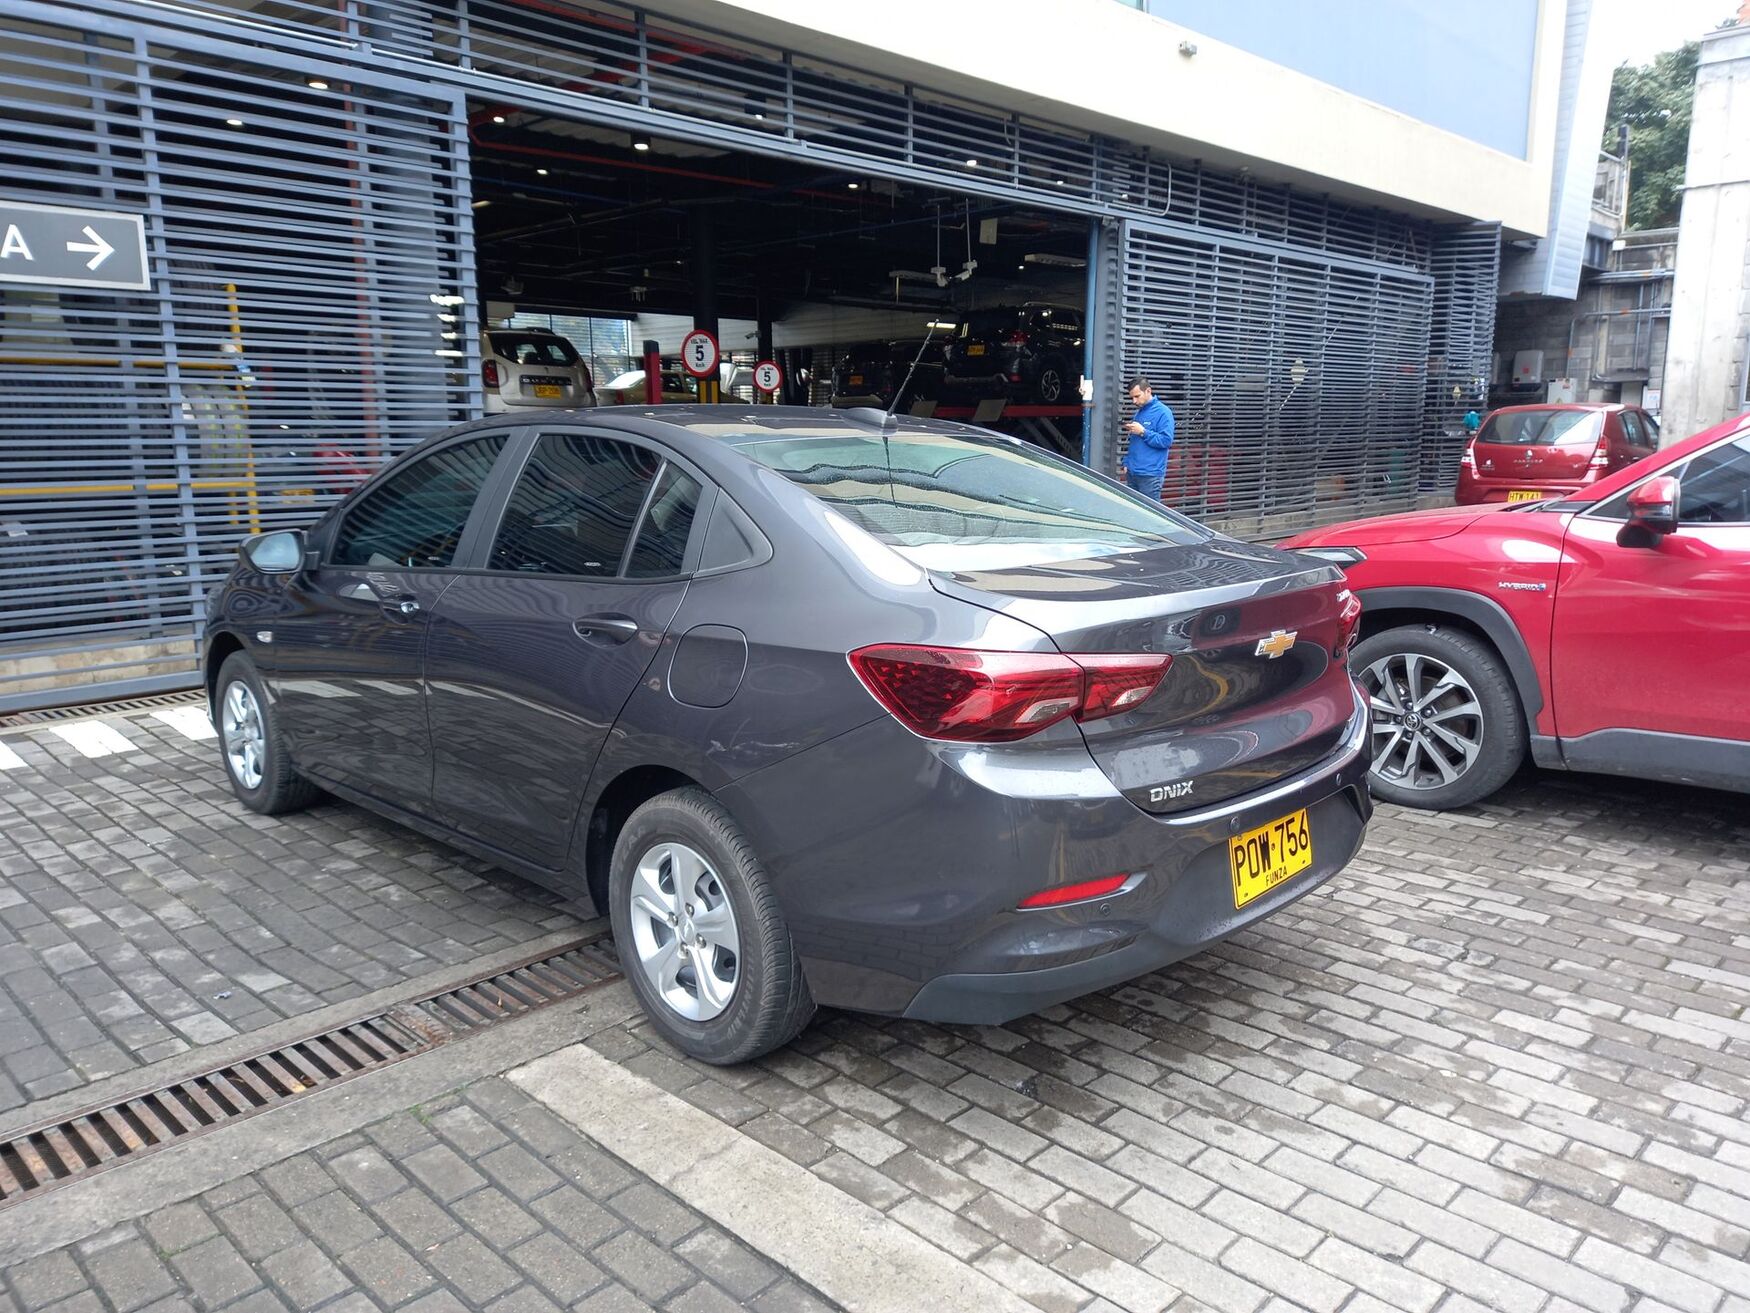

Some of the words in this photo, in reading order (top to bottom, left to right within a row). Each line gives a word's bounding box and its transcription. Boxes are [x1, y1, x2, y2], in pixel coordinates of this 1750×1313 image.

[1, 224, 34, 260] A
[695, 345, 704, 361] 5
[763, 371, 771, 382] 5
[1150, 780, 1194, 803] ONIX
[1234, 831, 1271, 887] POW
[1274, 811, 1309, 863] 756
[1265, 866, 1288, 887] FUNZA
